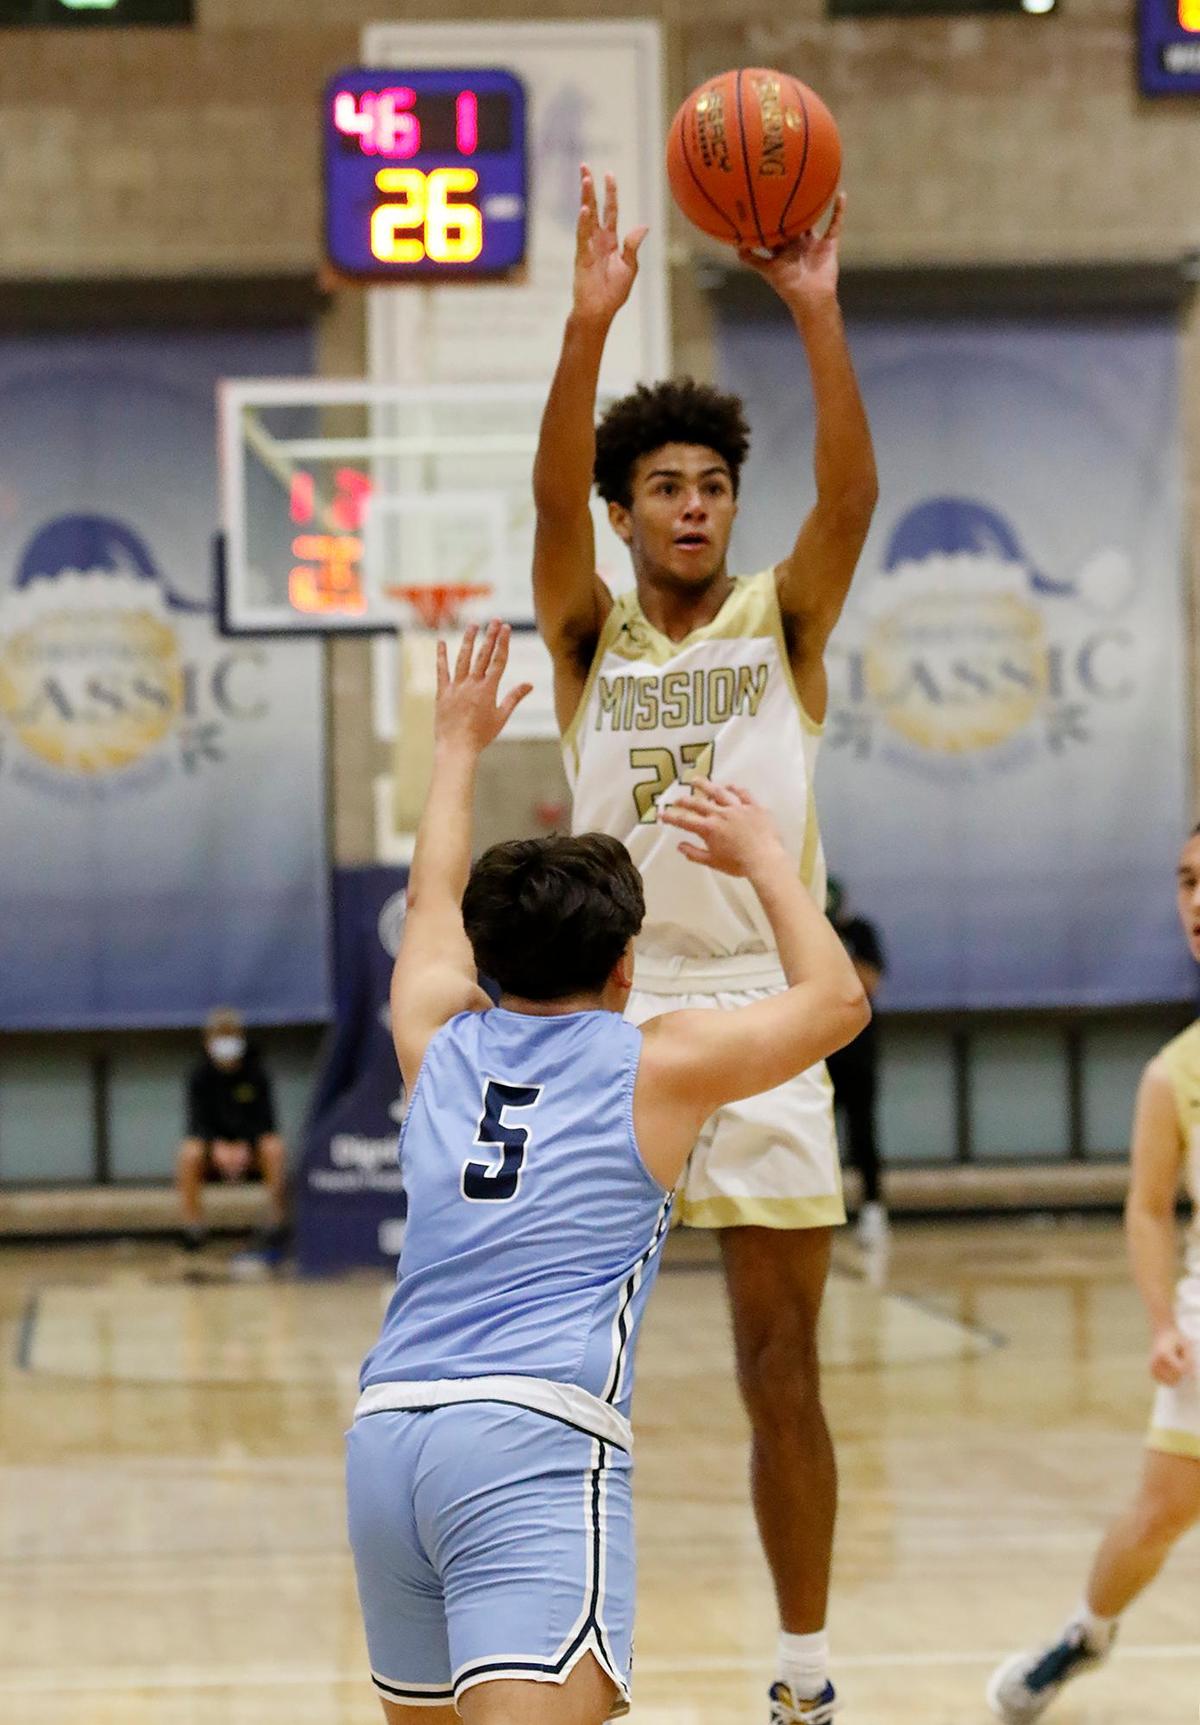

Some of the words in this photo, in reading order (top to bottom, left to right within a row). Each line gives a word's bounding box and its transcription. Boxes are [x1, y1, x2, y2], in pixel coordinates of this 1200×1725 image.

[334, 87, 421, 159] 46
[456, 89, 479, 156] 1
[370, 167, 483, 264] 26
[595, 664, 769, 731] MISSION
[460, 1076, 544, 1202] 5
